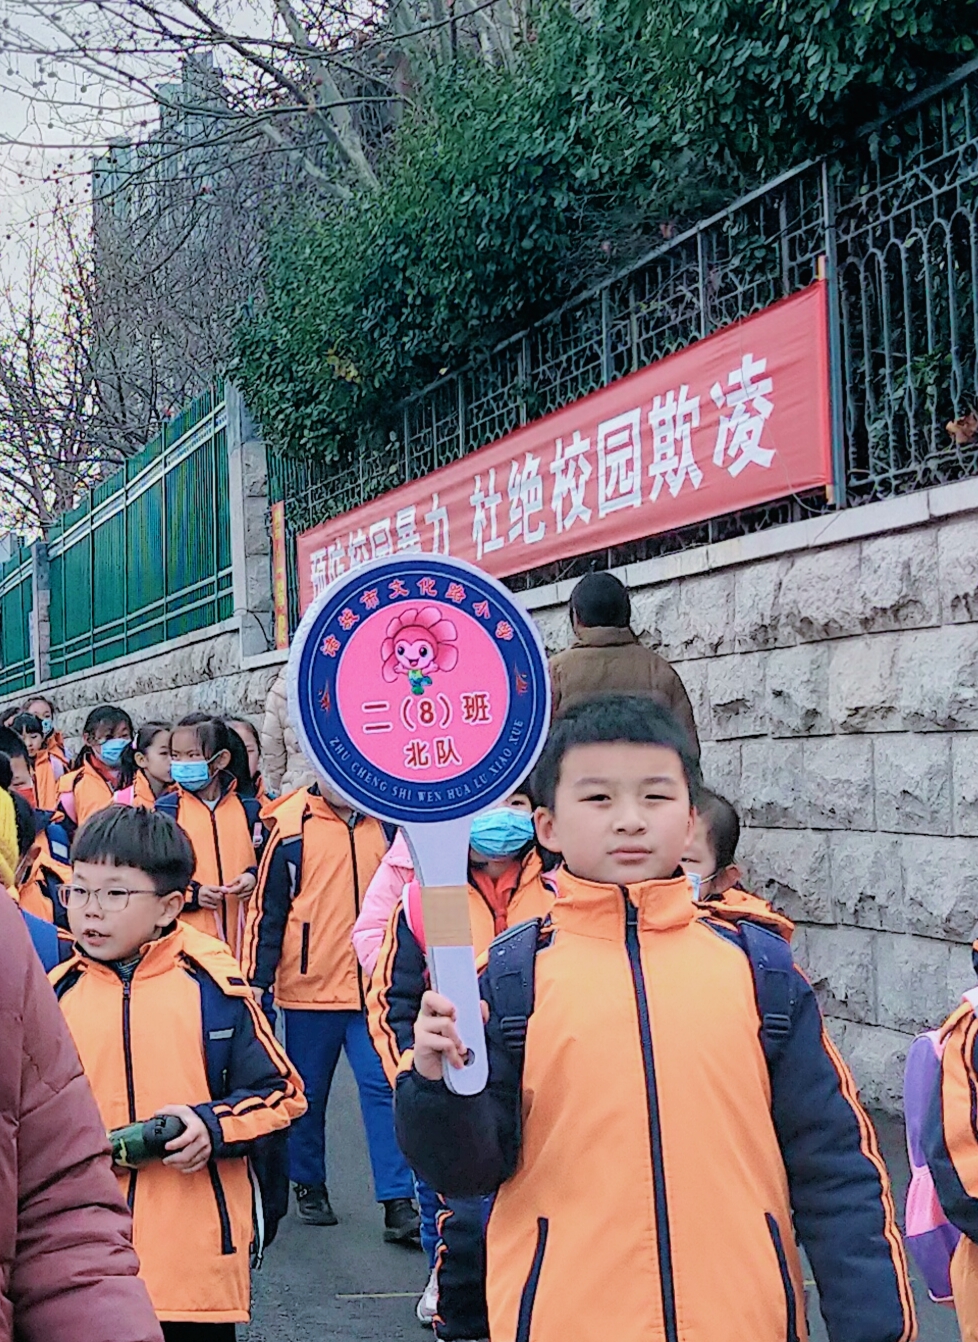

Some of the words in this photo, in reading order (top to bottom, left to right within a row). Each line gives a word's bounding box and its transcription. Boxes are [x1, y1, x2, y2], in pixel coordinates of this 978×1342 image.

[470, 353, 776, 560] 杜绝校园欺凌
[329, 736, 350, 761] ZHU
[351, 763, 388, 792] CHENG
[392, 786, 412, 801] SHI
[417, 791, 442, 802] WEN
[447, 786, 471, 800] HUA
[474, 773, 488, 788] LU
[489, 748, 512, 777] XIAO
[508, 719, 524, 746] XUE
[404, 737, 462, 768] 北队
